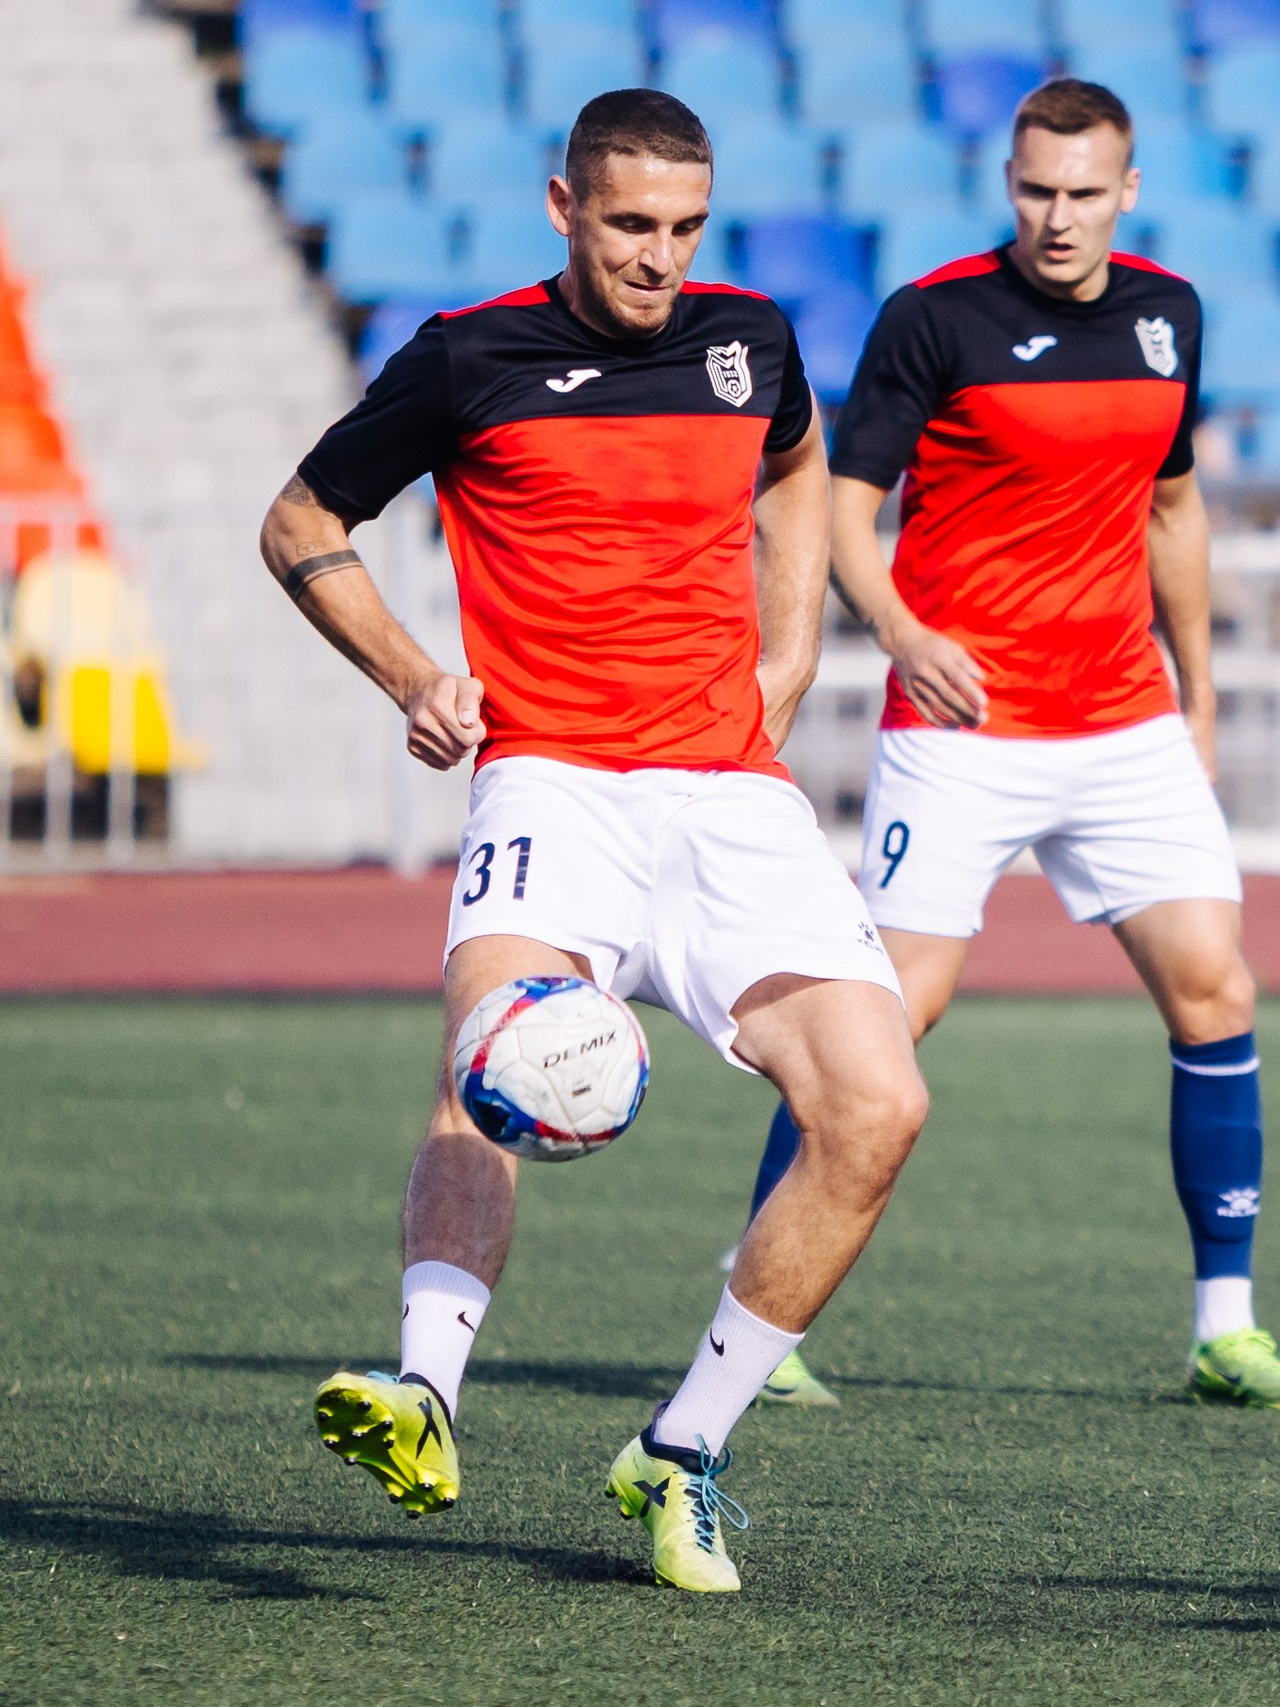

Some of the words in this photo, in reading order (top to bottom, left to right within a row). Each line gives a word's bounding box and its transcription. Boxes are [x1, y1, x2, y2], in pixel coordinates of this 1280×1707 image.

[462, 836, 532, 907] 31
[880, 820, 910, 890] 9
[543, 1029, 616, 1070] DEMIX
